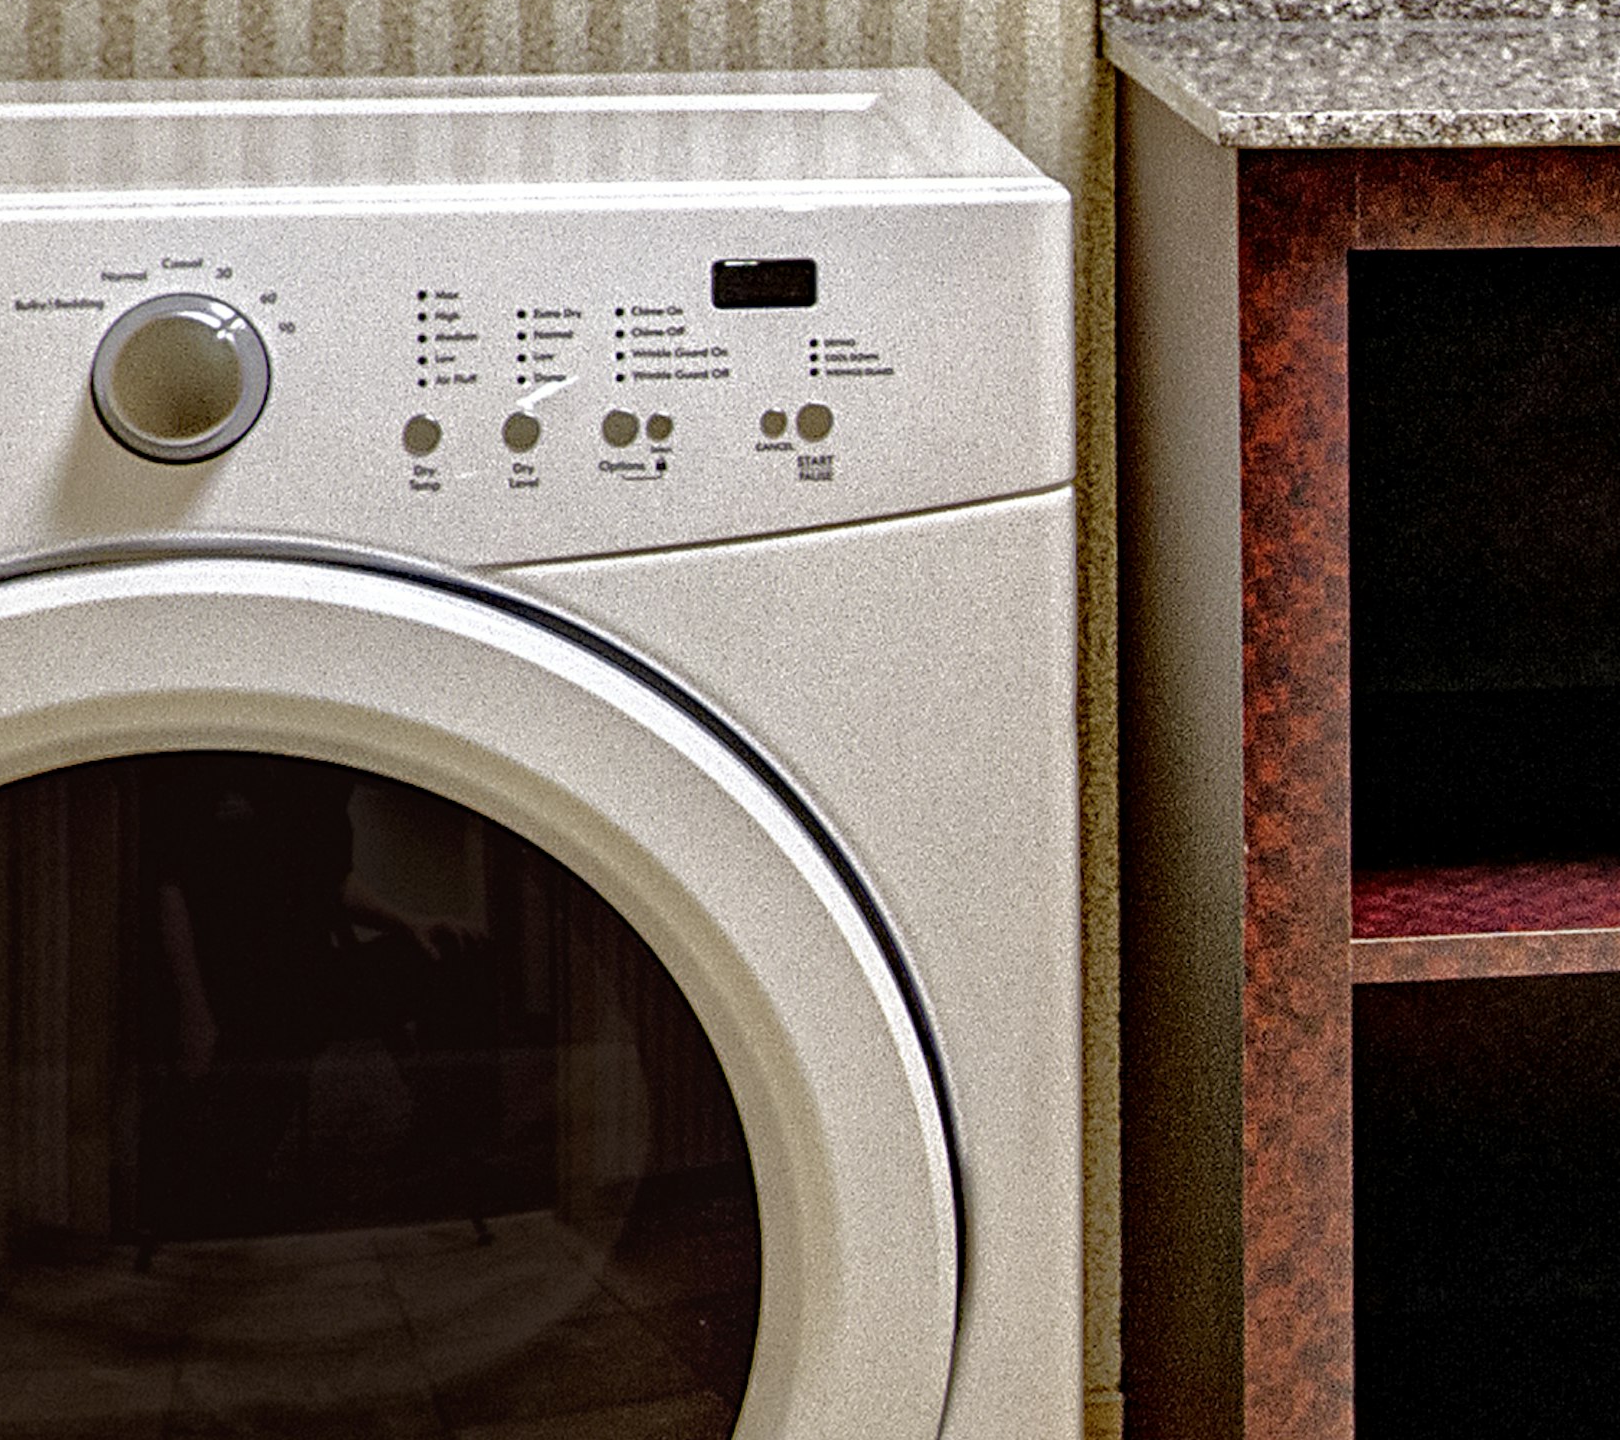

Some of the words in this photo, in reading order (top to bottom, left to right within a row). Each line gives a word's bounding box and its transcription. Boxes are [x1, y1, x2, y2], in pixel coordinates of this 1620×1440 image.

[100, 270, 148, 282] Normal
[216, 268, 233, 279] 30
[260, 293, 278, 304] 60
[278, 322, 296, 334] 90
[755, 442, 795, 452] CANCEL
[598, 460, 646, 473] Options
[797, 455, 834, 467] START
[413, 464, 437, 477] Dry
[513, 462, 535, 475] Dry
[408, 479, 441, 492] Temp
[507, 477, 540, 489] Level
